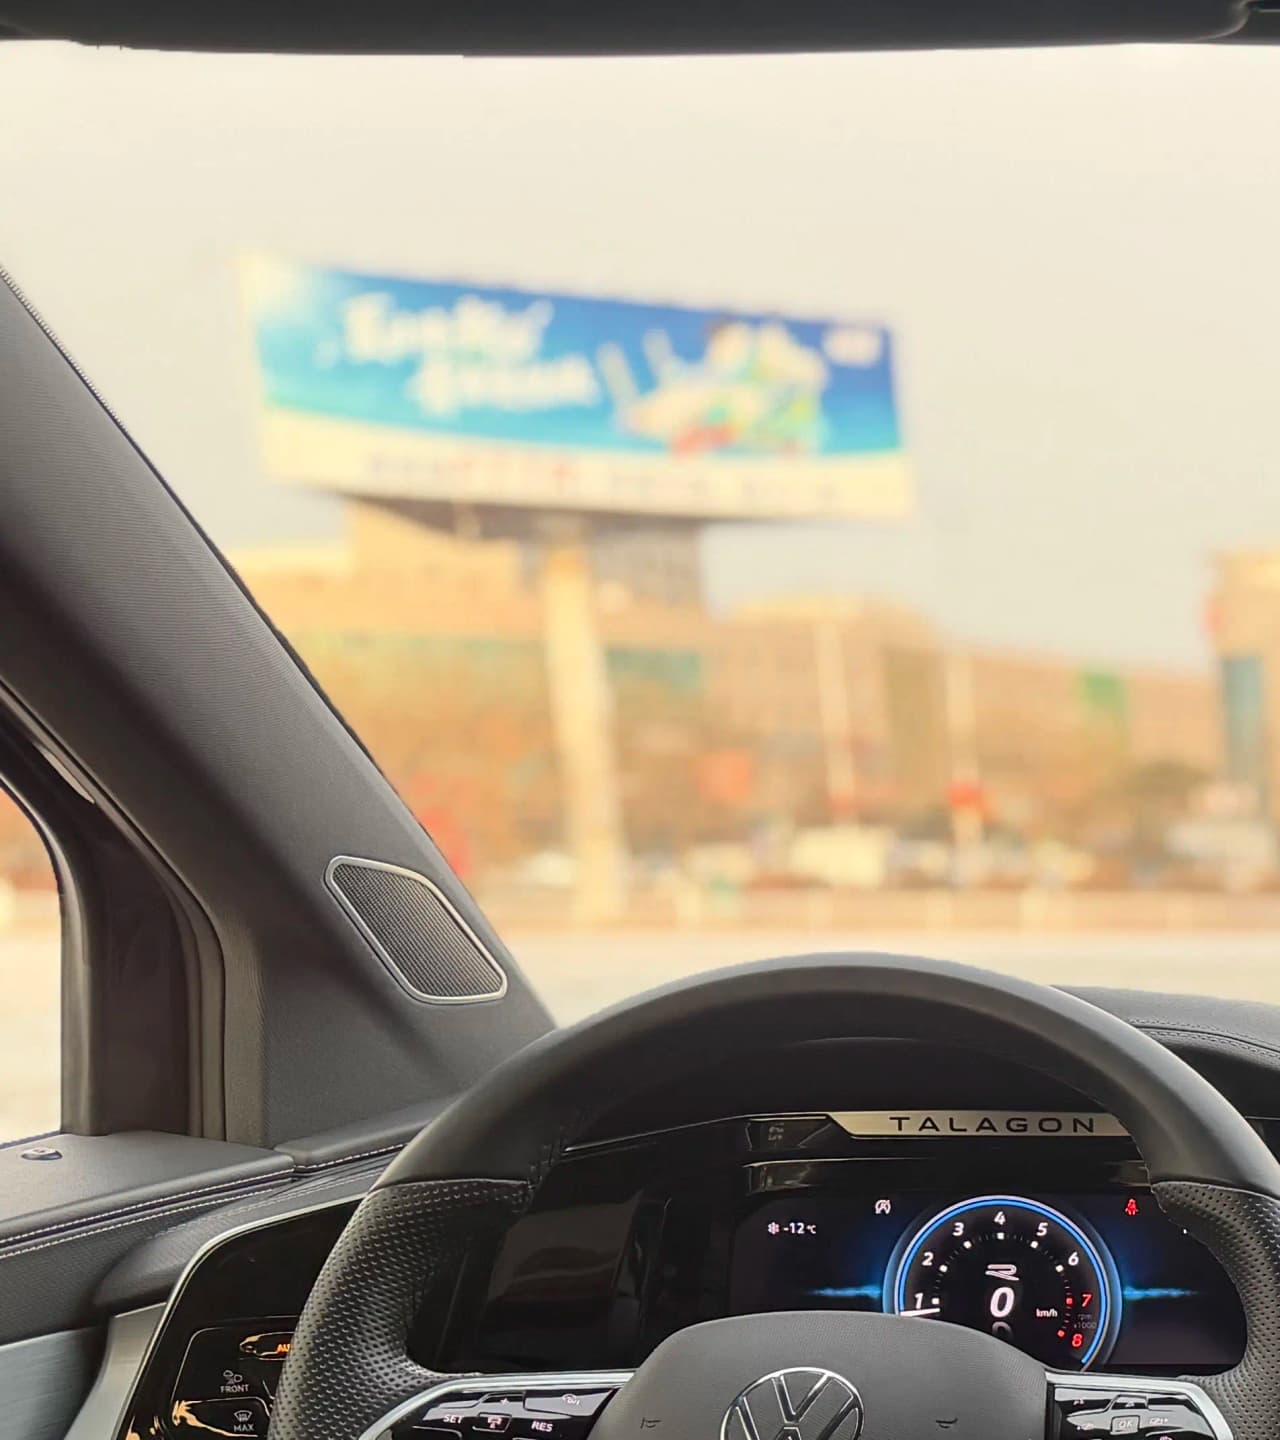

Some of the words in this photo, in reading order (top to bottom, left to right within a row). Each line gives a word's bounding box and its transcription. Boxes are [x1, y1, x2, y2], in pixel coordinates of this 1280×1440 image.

[889, 1116, 1095, 1134] TALAGON
[994, 1211, 1006, 1225] 4
[953, 1222, 964, 1236] 3
[1037, 1222, 1048, 1236] 5
[922, 1252, 933, 1267] 2
[1068, 1252, 1079, 1266] 6
[914, 1293, 924, 1310] 1
[990, 1286, 1015, 1318] 0
[1081, 1294, 1092, 1308] 7
[1036, 1308, 1058, 1319] km/h
[1072, 1335, 1083, 1347] 8
[220, 1383, 250, 1394] FRONT
[443, 1413, 465, 1424] SET
[233, 1423, 254, 1433] MAX
[531, 1420, 554, 1433] RES
